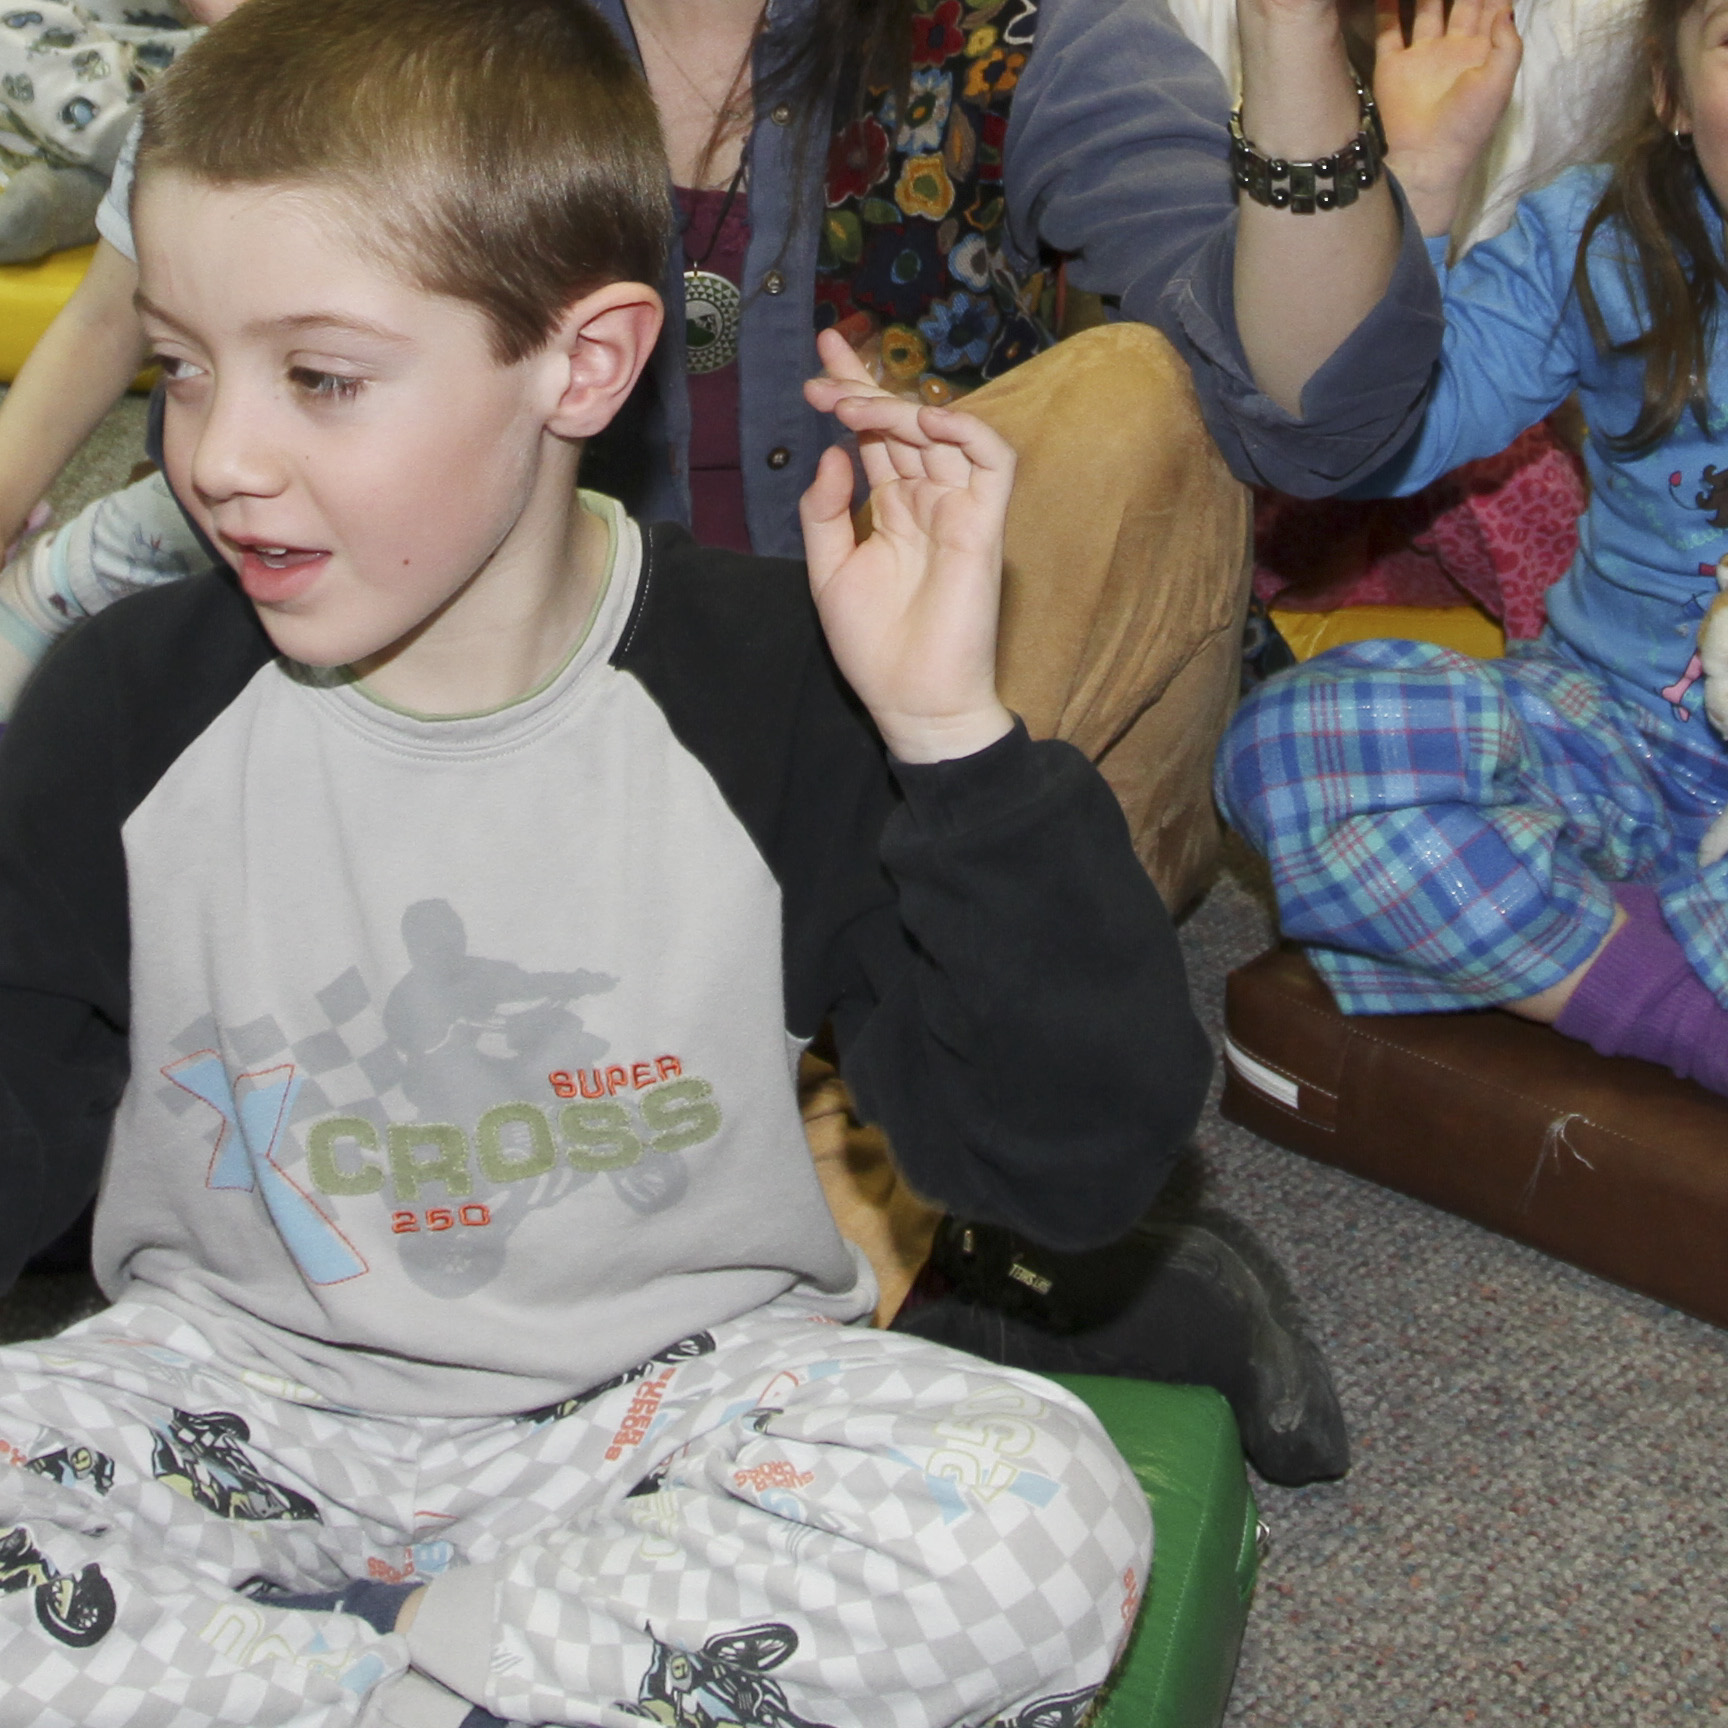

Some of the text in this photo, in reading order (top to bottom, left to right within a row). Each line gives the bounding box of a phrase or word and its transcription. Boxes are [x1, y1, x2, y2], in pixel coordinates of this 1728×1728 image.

[548, 1055, 683, 1100] SUPER
[305, 1074, 724, 1202] CROSS
[390, 1204, 492, 1235] 250
